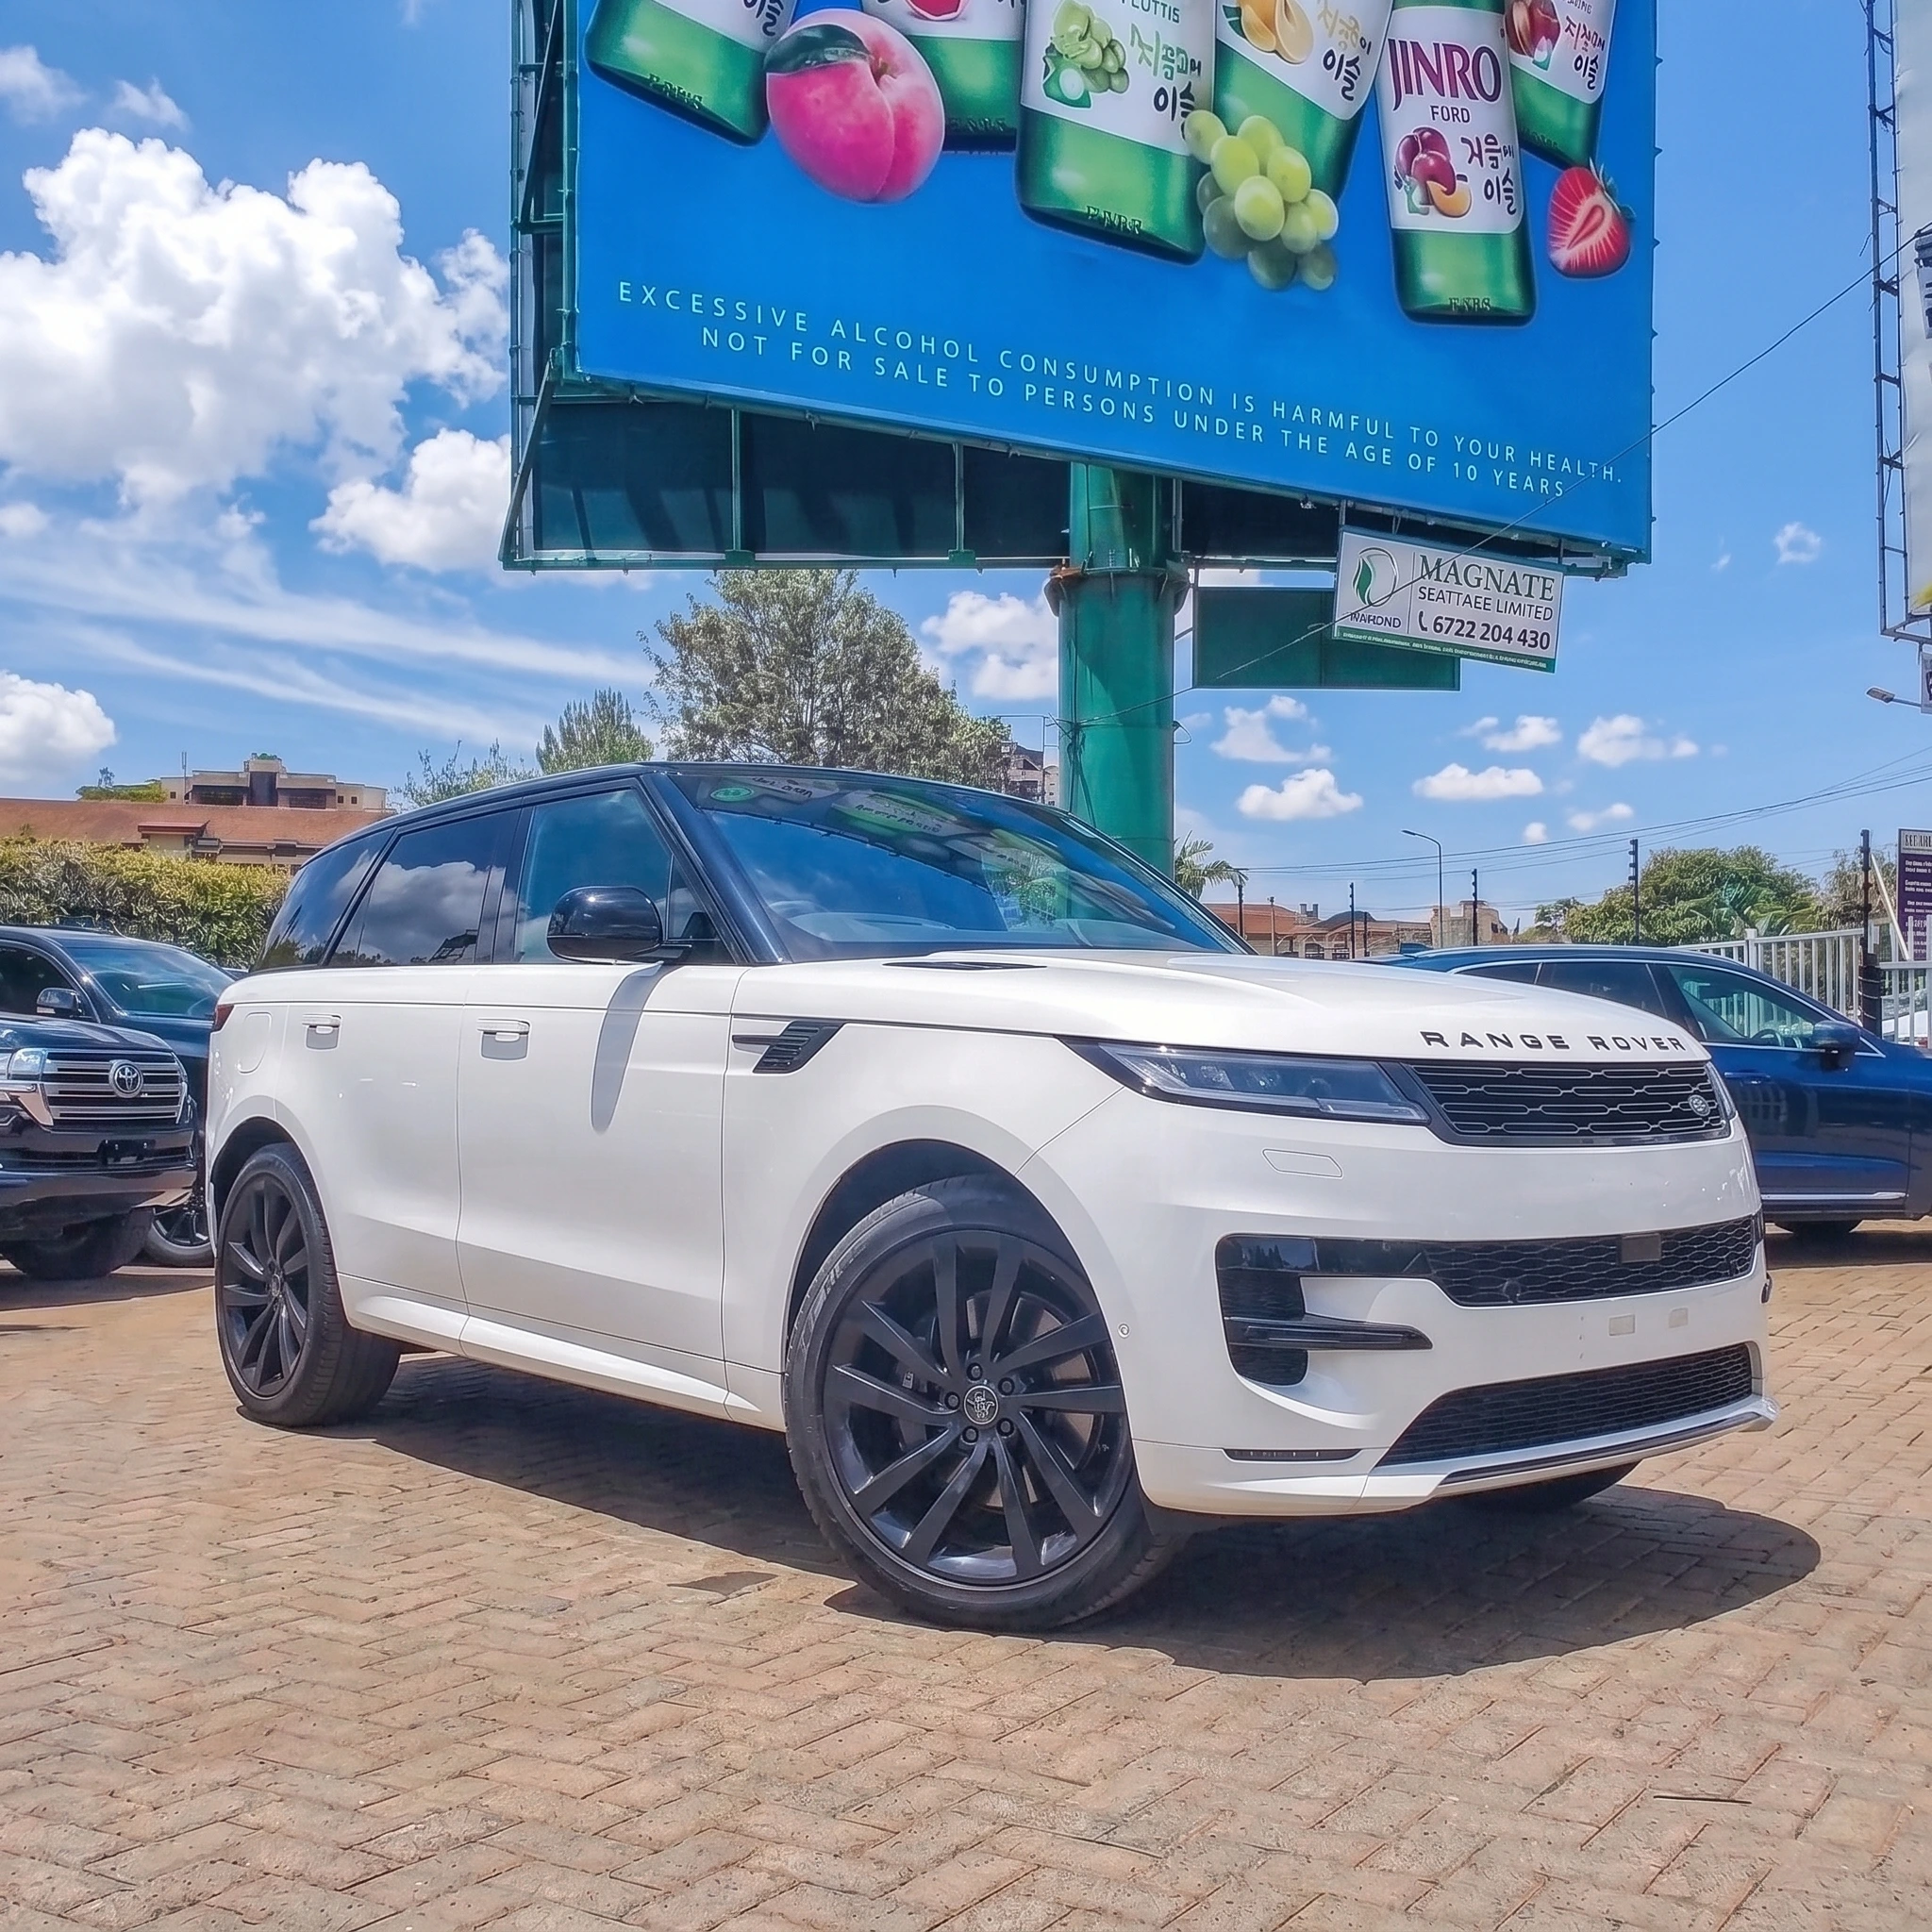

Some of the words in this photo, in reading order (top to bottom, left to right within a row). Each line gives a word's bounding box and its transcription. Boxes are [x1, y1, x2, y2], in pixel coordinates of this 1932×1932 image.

[1388, 39, 1502, 110] JINRO
[1430, 105, 1471, 124] FORD
[1484, 167, 1517, 215] 이슬
[620, 281, 808, 332] EXCESSIVE
[830, 319, 979, 363] ALCOHOL
[999, 350, 1214, 406] CONSUMPTION
[1232, 392, 1255, 412] IS
[1273, 400, 1394, 439] HARMFUL
[1409, 425, 1439, 447] TO
[1453, 435, 1515, 462] YOUR
[1530, 450, 1621, 482] HEALTH.
[703, 326, 767, 356] NOT
[791, 341, 851, 371] FOR
[874, 357, 948, 388] SALE
[968, 373, 1004, 396] TO
[1025, 383, 1154, 423] PERSONS
[1174, 409, 1263, 442] UNDER
[1280, 429, 1327, 454] THE
[1345, 441, 1391, 465] AGE
[1408, 453, 1436, 473] OF
[1453, 461, 1477, 481] 10
[1493, 469, 1563, 497] YEARS
[1419, 555, 1556, 602] MAGNATE
[1432, 615, 1476, 639] 6722
[1479, 623, 1513, 644] 204
[1517, 629, 1550, 650] 430
[1495, 599, 1554, 622] LIMITED
[1421, 1031, 1570, 1050] RANGE
[1587, 1035, 1686, 1052] ROVER
